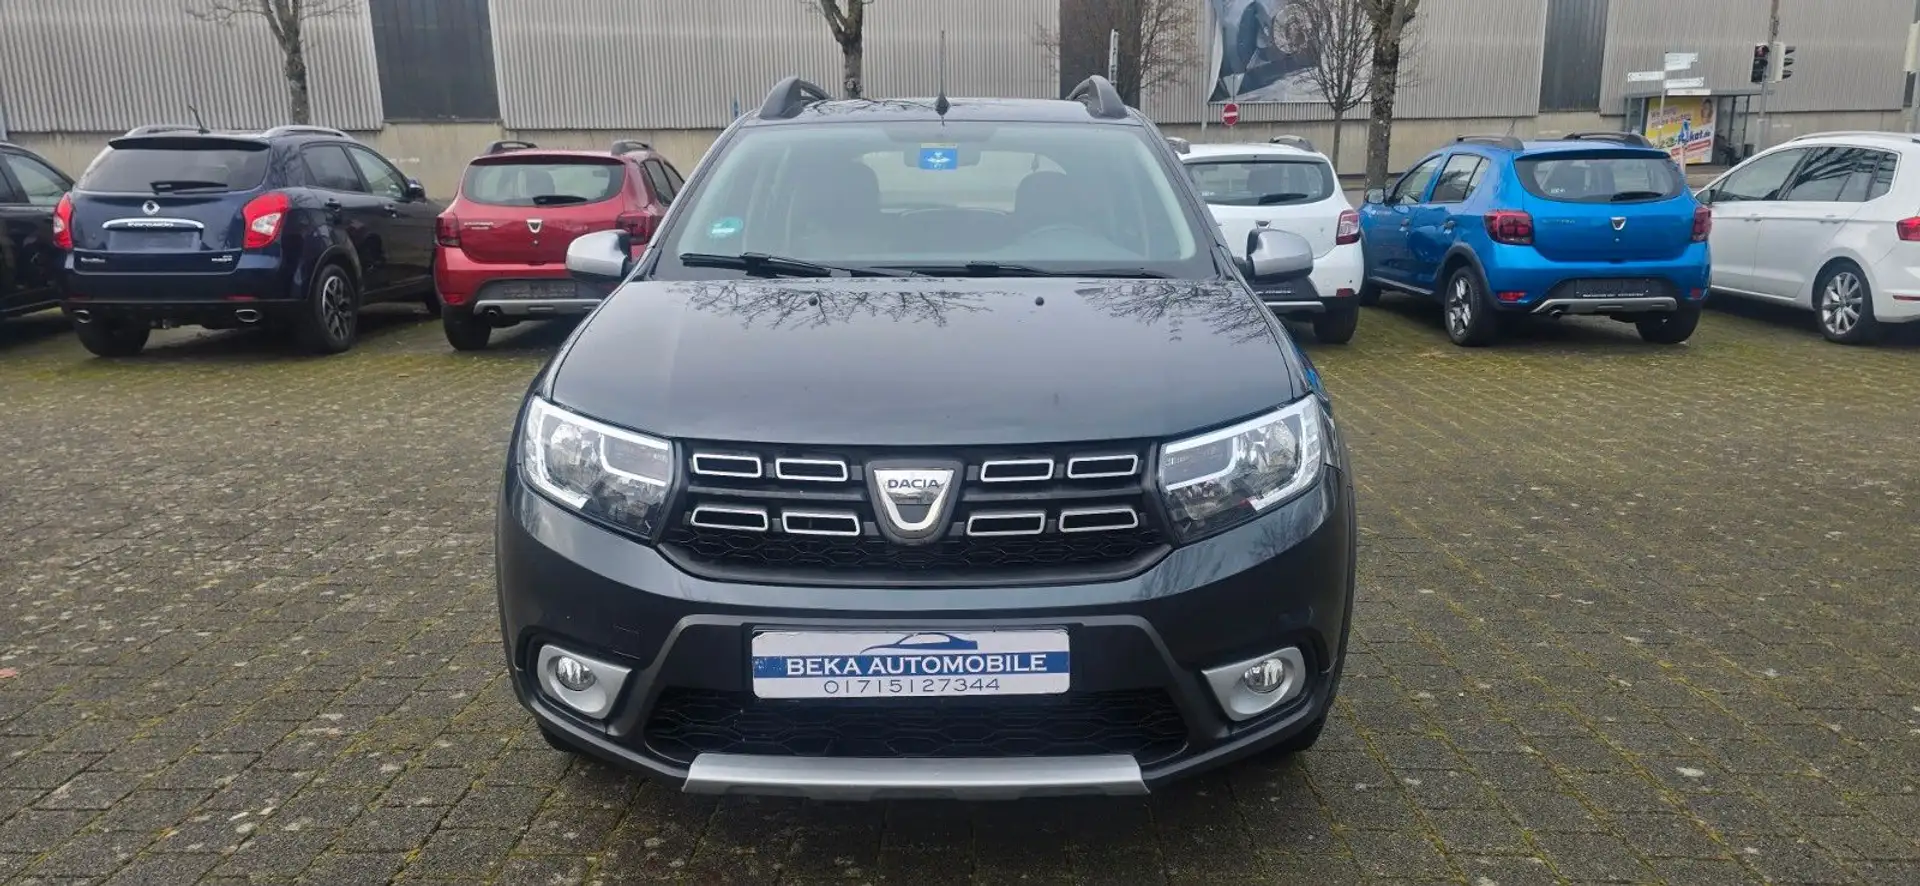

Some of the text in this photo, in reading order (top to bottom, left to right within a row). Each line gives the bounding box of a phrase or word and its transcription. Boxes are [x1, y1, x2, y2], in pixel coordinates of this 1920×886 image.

[888, 479, 940, 489] DACIA
[786, 654, 1048, 675] BEKA AUTOMOBILE
[824, 678, 1000, 694] 01715127344
